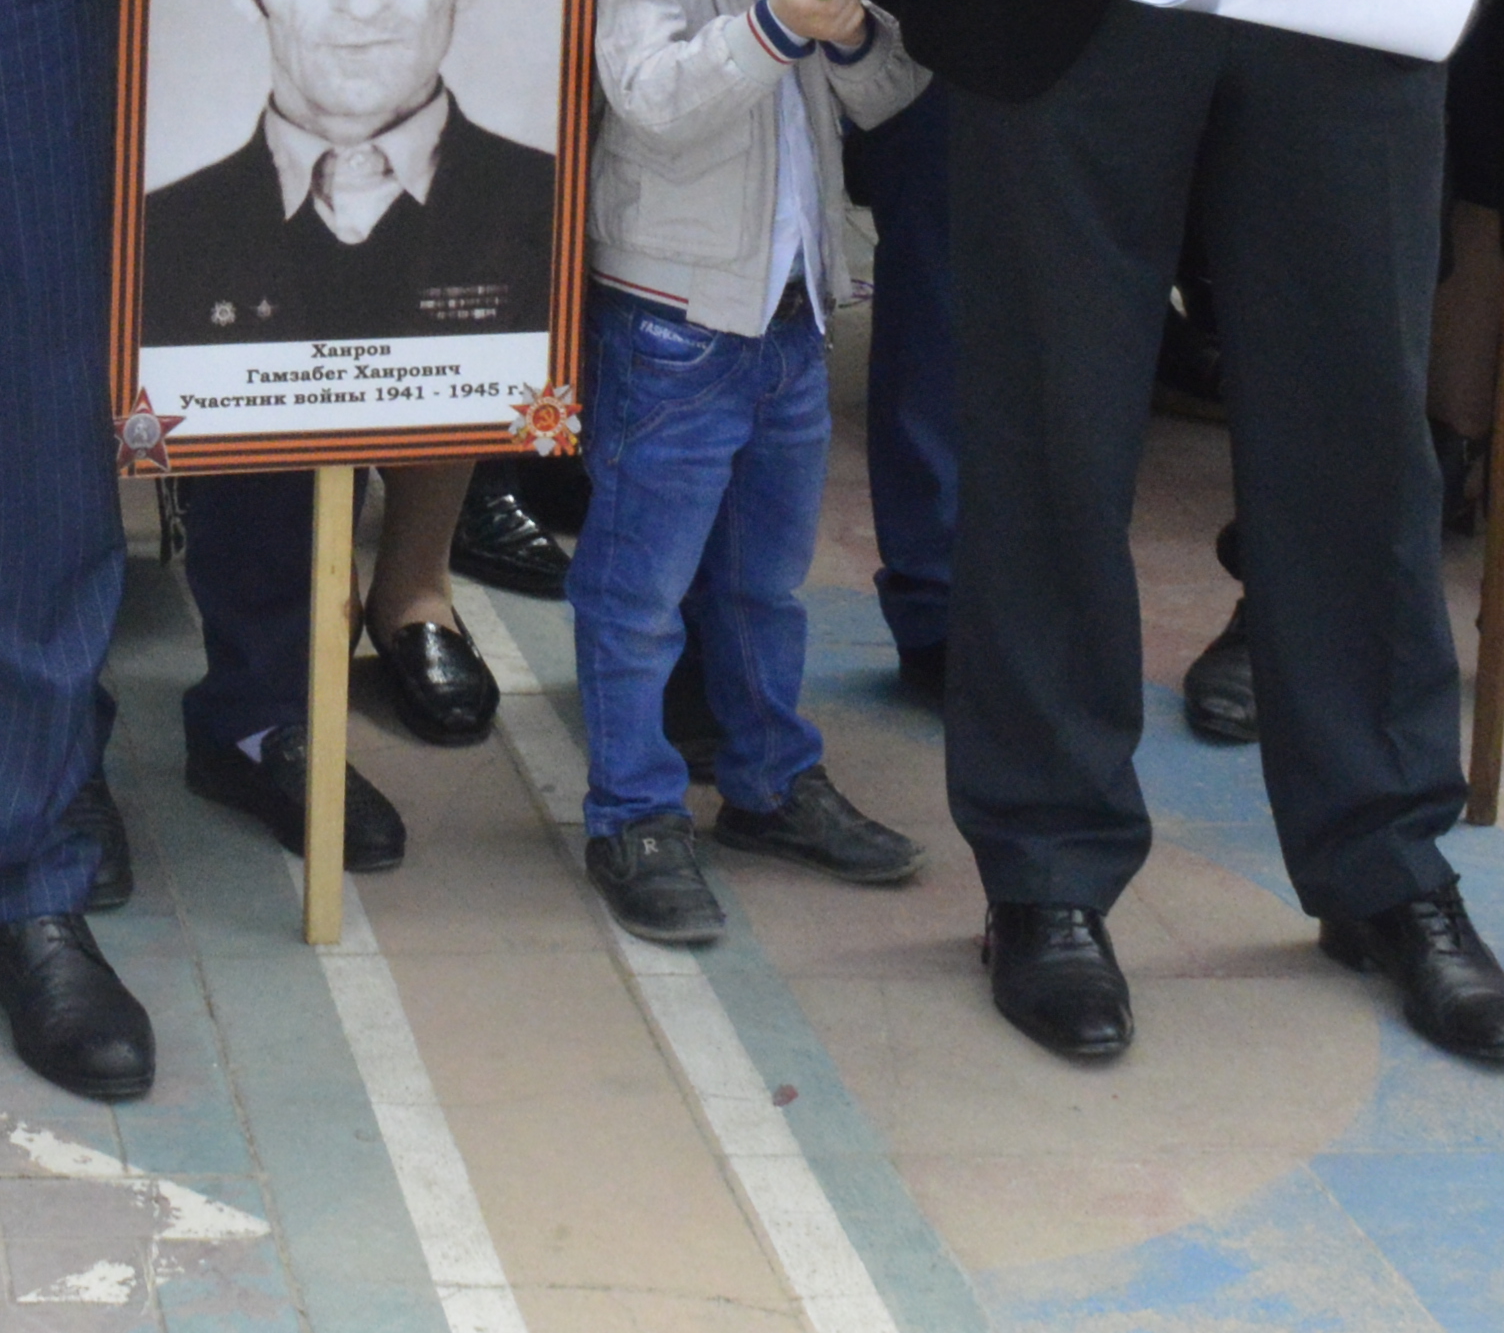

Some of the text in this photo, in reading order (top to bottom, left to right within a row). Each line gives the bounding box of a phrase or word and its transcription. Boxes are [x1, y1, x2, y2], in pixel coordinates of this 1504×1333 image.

[246, 365, 348, 384] Гамзабег
[180, 393, 286, 410] Участник
[293, 388, 366, 405] войны
[375, 385, 424, 401] 1941
[449, 382, 500, 398] 1945
[643, 838, 659, 855] R
